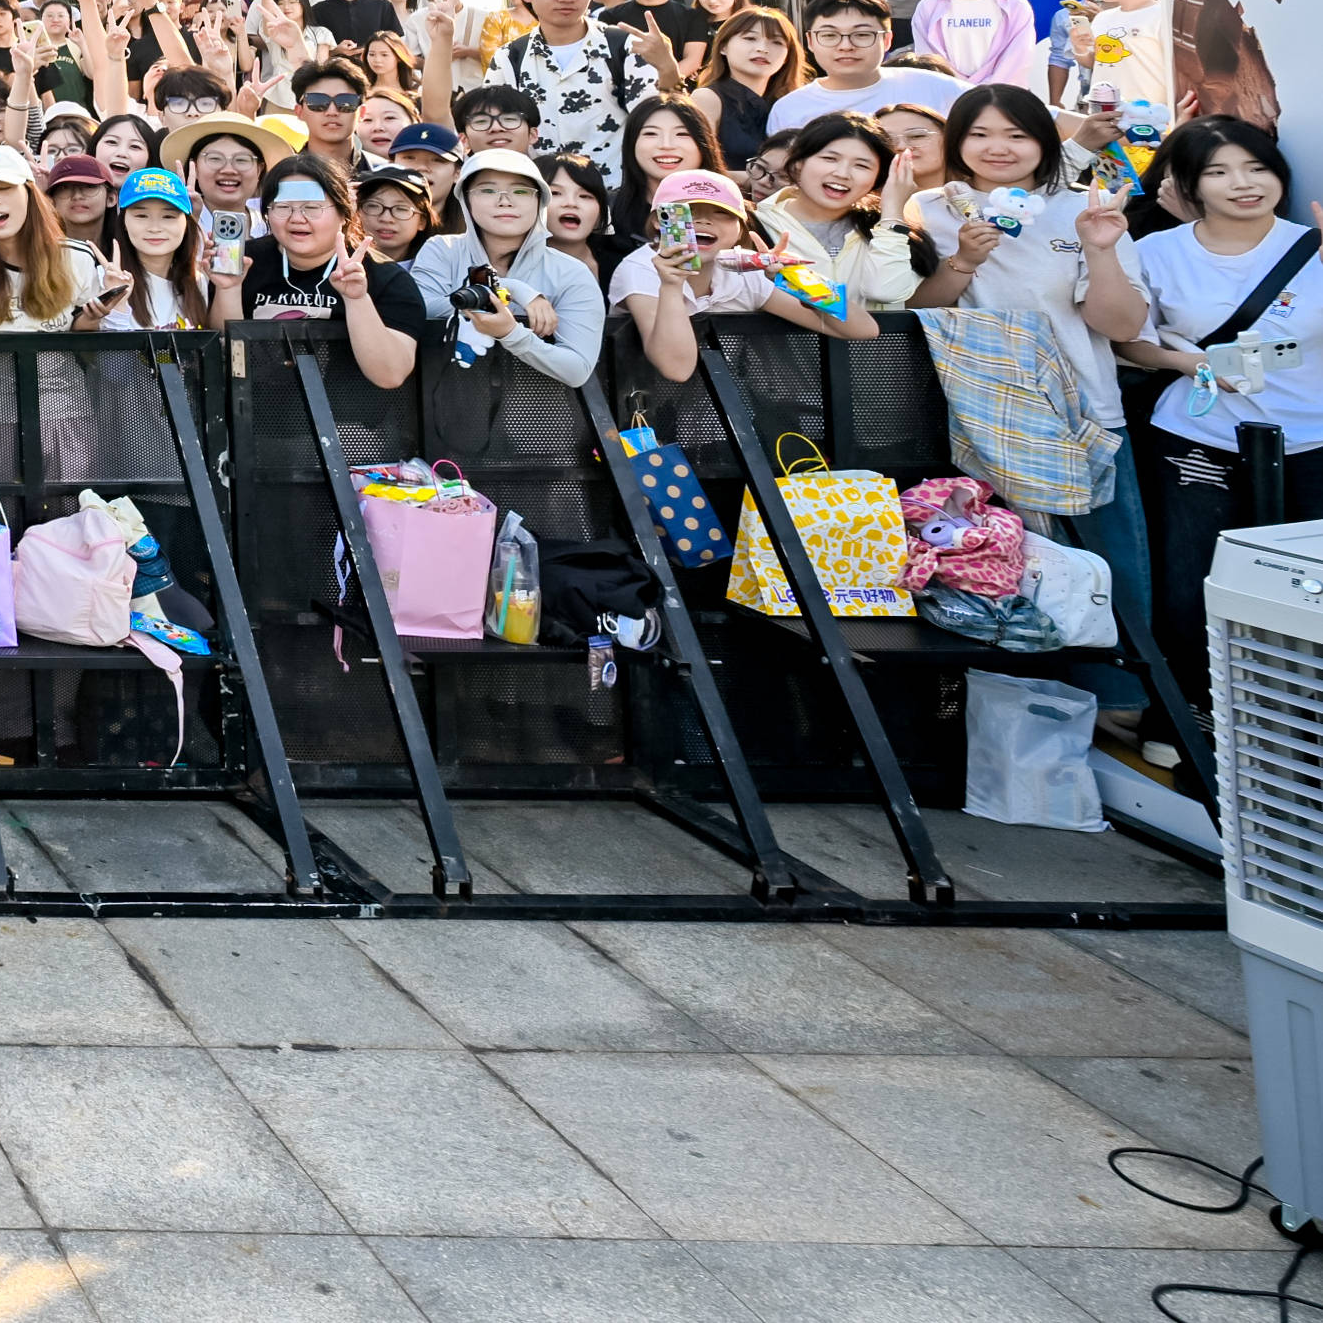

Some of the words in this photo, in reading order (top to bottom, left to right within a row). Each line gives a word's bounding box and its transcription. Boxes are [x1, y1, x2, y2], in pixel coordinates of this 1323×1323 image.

[947, 17, 993, 28] FLANEUR
[834, 588, 897, 604] 元气好物
